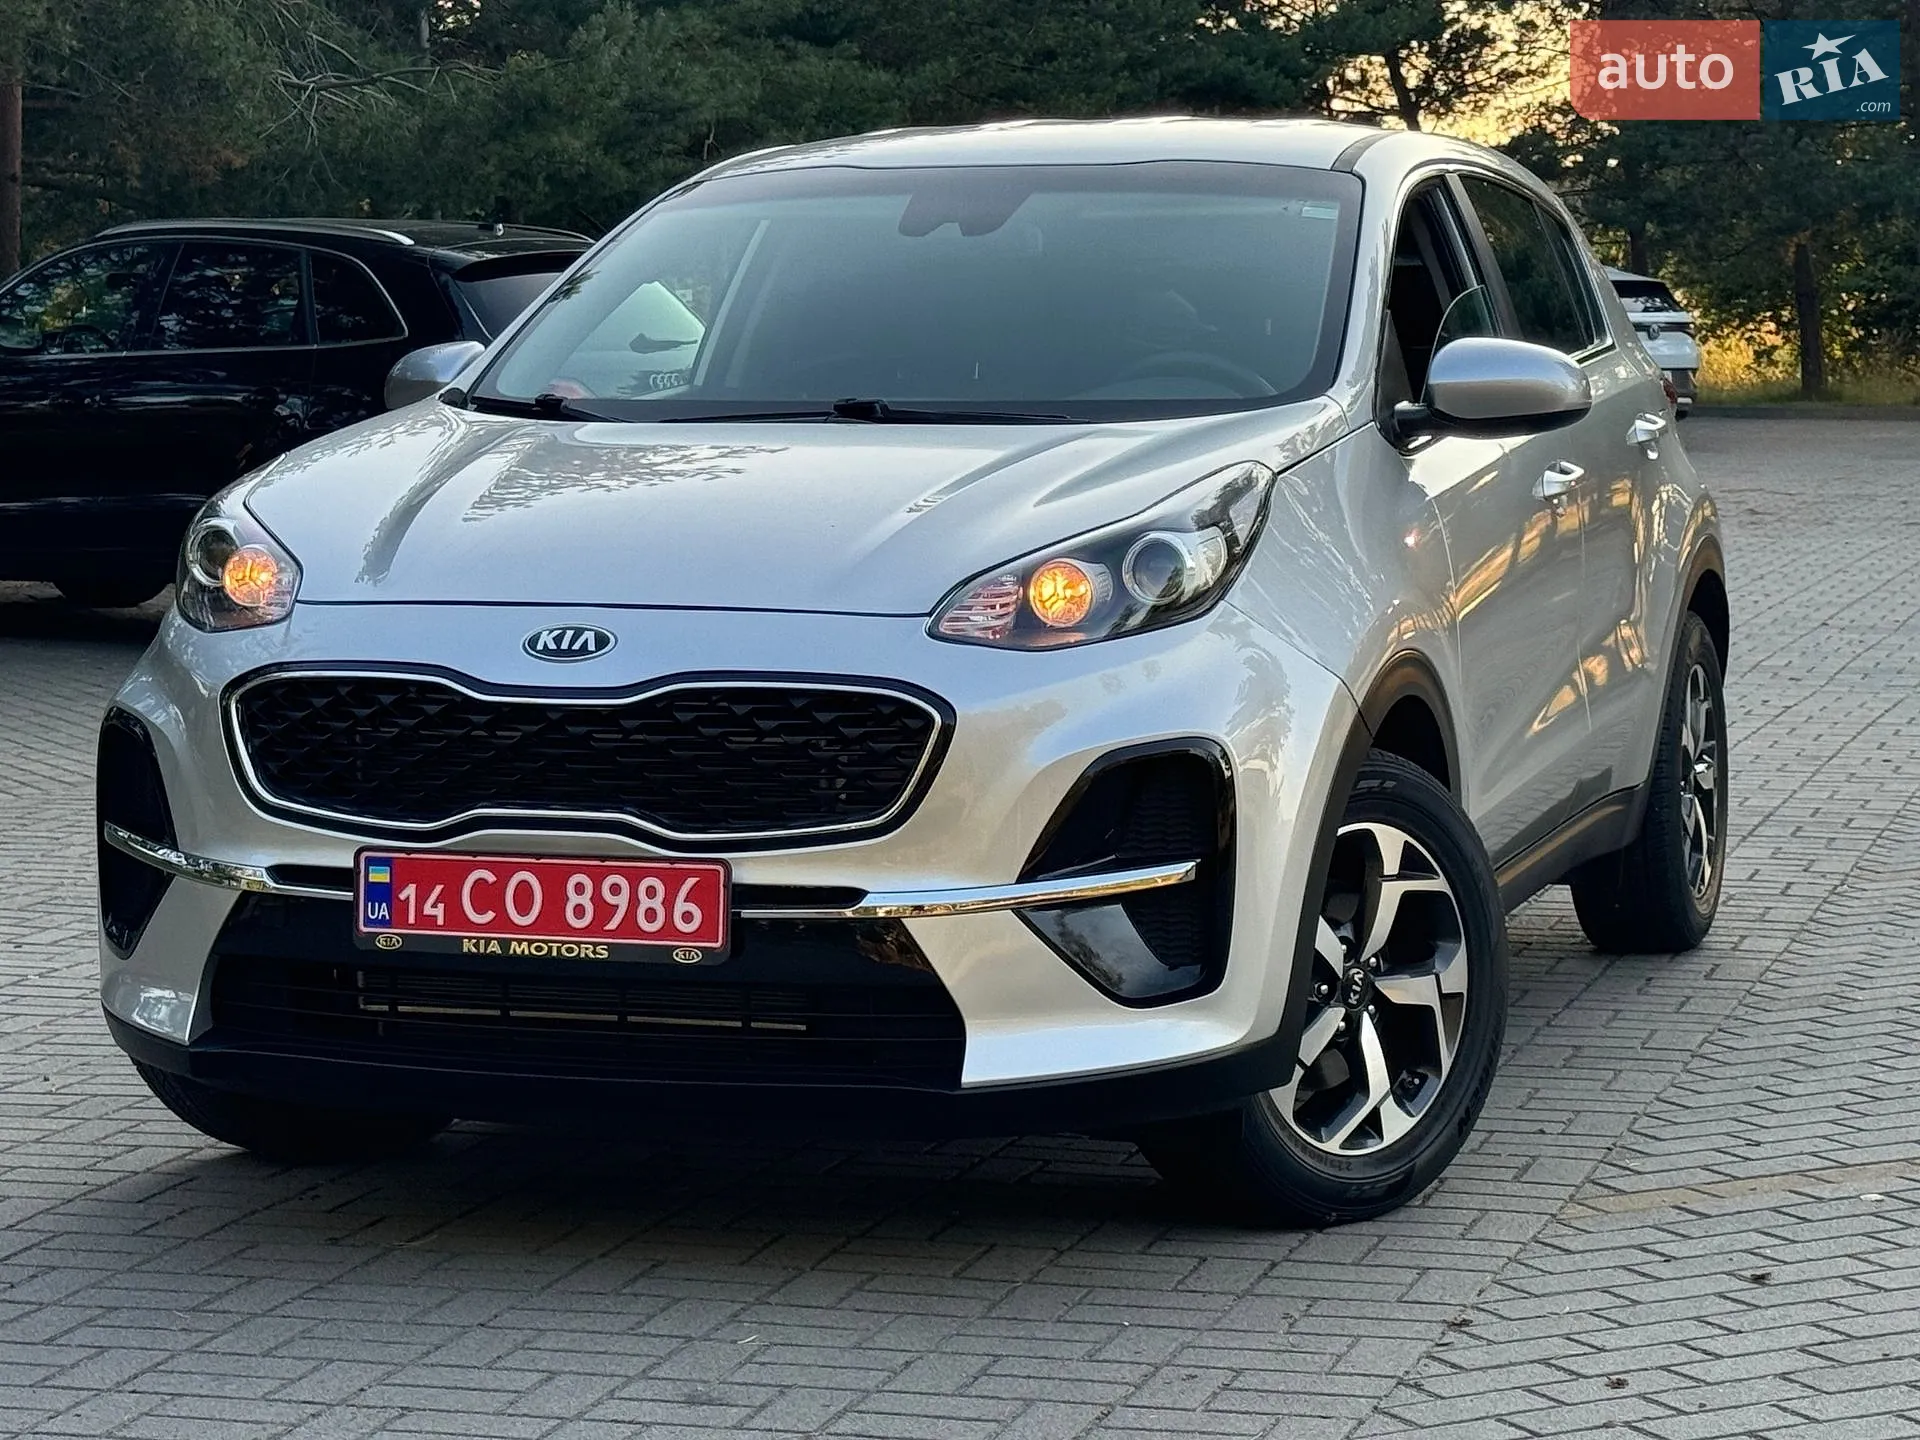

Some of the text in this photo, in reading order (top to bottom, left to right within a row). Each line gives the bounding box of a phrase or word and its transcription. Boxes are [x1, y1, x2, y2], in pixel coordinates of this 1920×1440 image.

[536, 629, 596, 651] KIA
[367, 901, 390, 921] UA
[398, 868, 703, 933] 14 CO 8986
[462, 938, 609, 959] KIA MOTORS
[1348, 972, 1364, 1005] KIA
